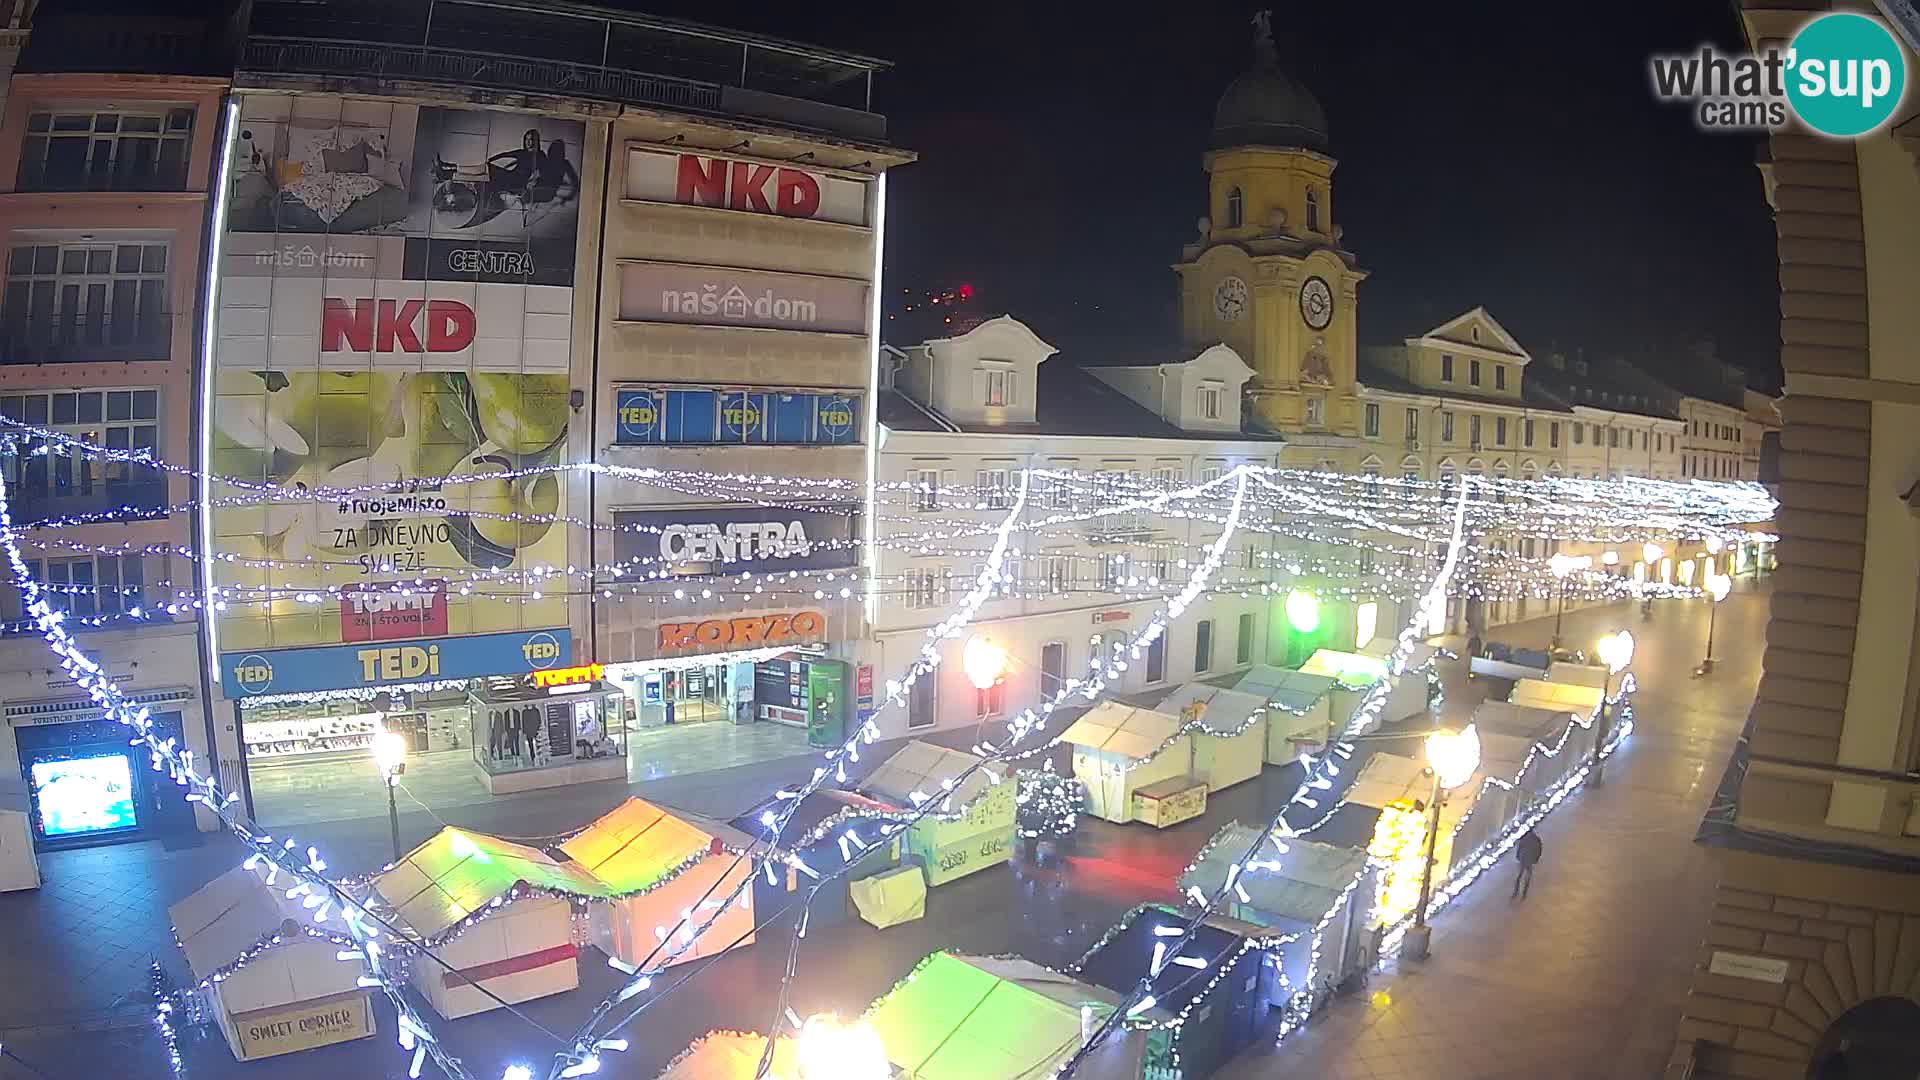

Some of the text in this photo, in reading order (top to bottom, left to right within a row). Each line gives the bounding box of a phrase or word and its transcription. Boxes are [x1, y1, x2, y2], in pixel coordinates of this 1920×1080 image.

[676, 153, 821, 218] NKD
[320, 247, 367, 268] dom
[449, 249, 535, 275] CENTRA
[662, 284, 817, 322] naš dom
[321, 298, 477, 353] NKD
[619, 407, 657, 425] TEDi
[333, 523, 450, 549] ZA DNEVNO
[659, 520, 811, 562] CENTRA
[660, 611, 825, 650] KORZO
[358, 644, 440, 682] TEDi
[522, 641, 560, 660] TEDi
[234, 665, 273, 683] TEDi
[250, 1021, 293, 1041] SWEET
